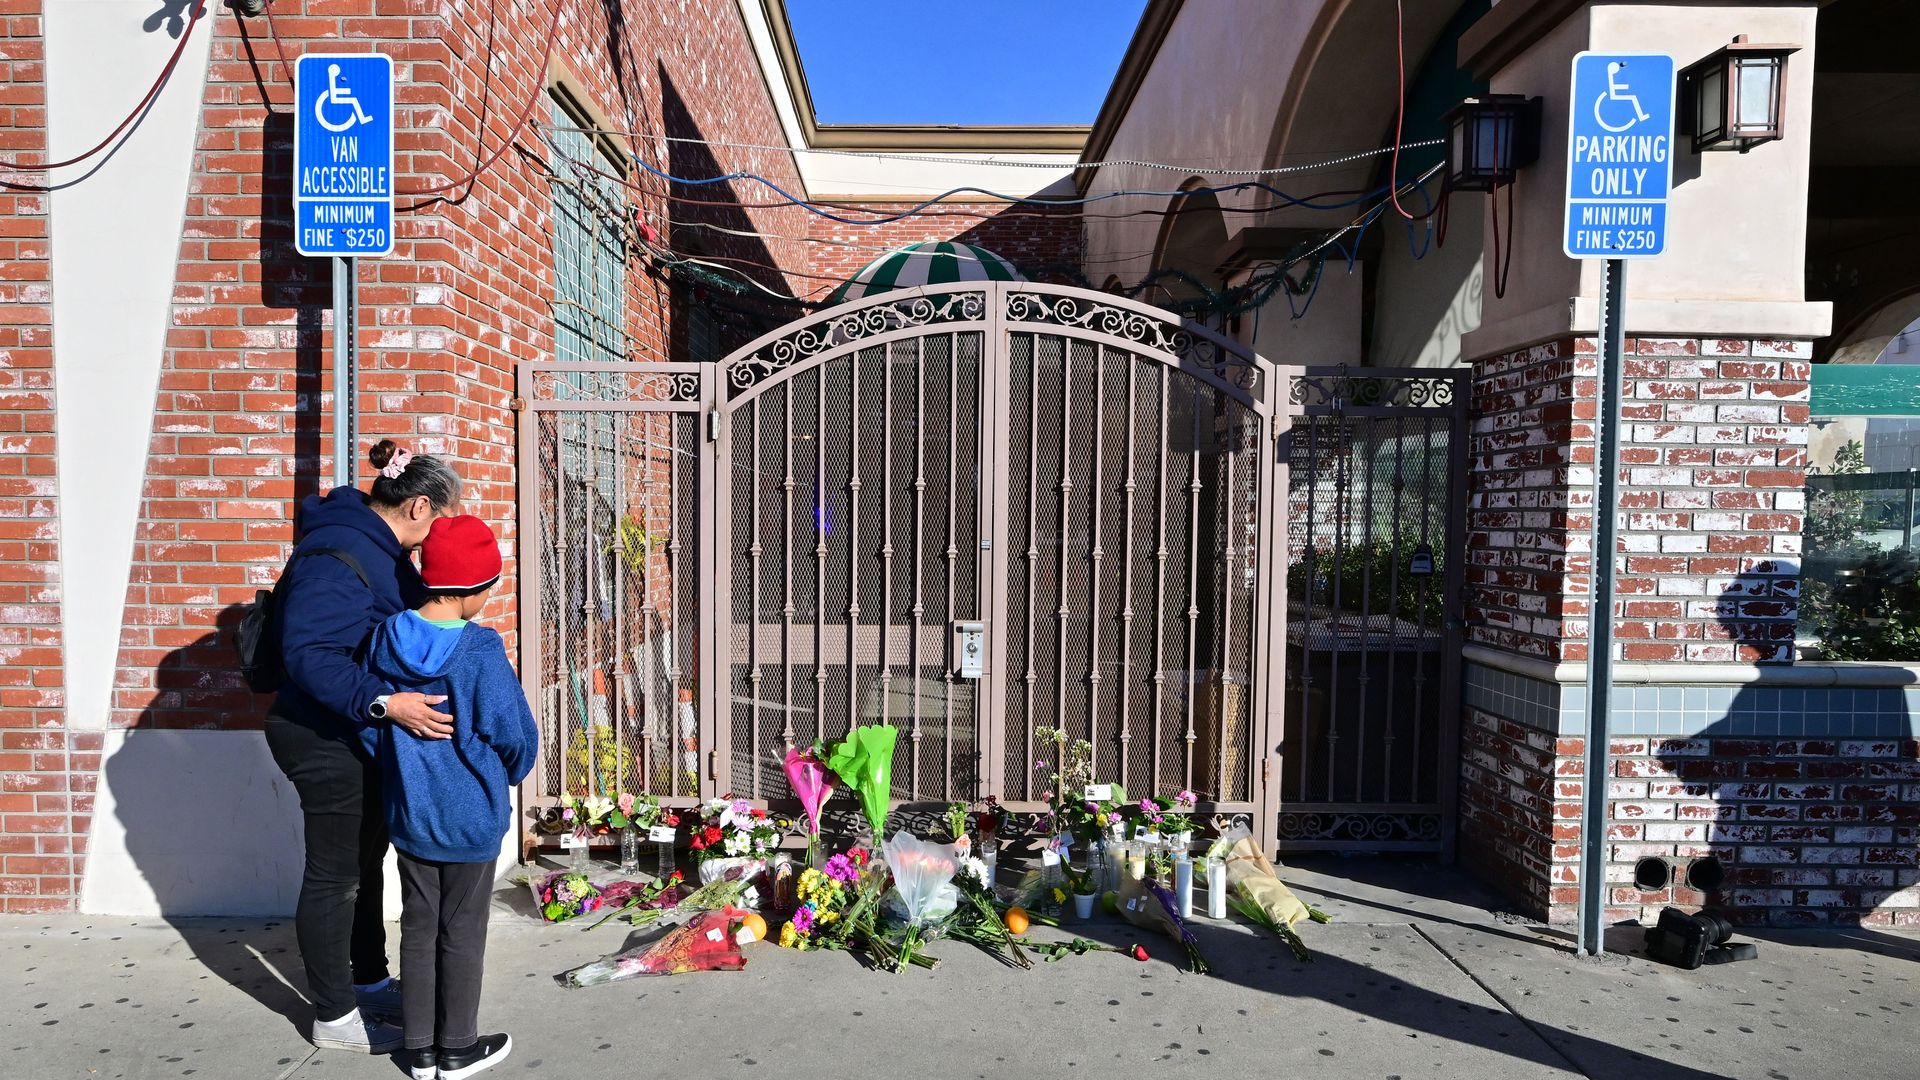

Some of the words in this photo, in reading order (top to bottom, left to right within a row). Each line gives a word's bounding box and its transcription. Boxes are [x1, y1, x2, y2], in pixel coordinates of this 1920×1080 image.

[331, 136, 358, 163] VAN
[1575, 135, 1666, 163] PARKING
[302, 166, 387, 194] ACCESSIBLE
[1591, 168, 1648, 195] ONLY
[314, 205, 375, 224] MINIMUM
[1582, 206, 1653, 226] MINIMUM
[304, 228, 334, 247] FINE
[346, 228, 385, 249] $250
[1576, 230, 1611, 249] FINE
[1617, 229, 1656, 251] $250
